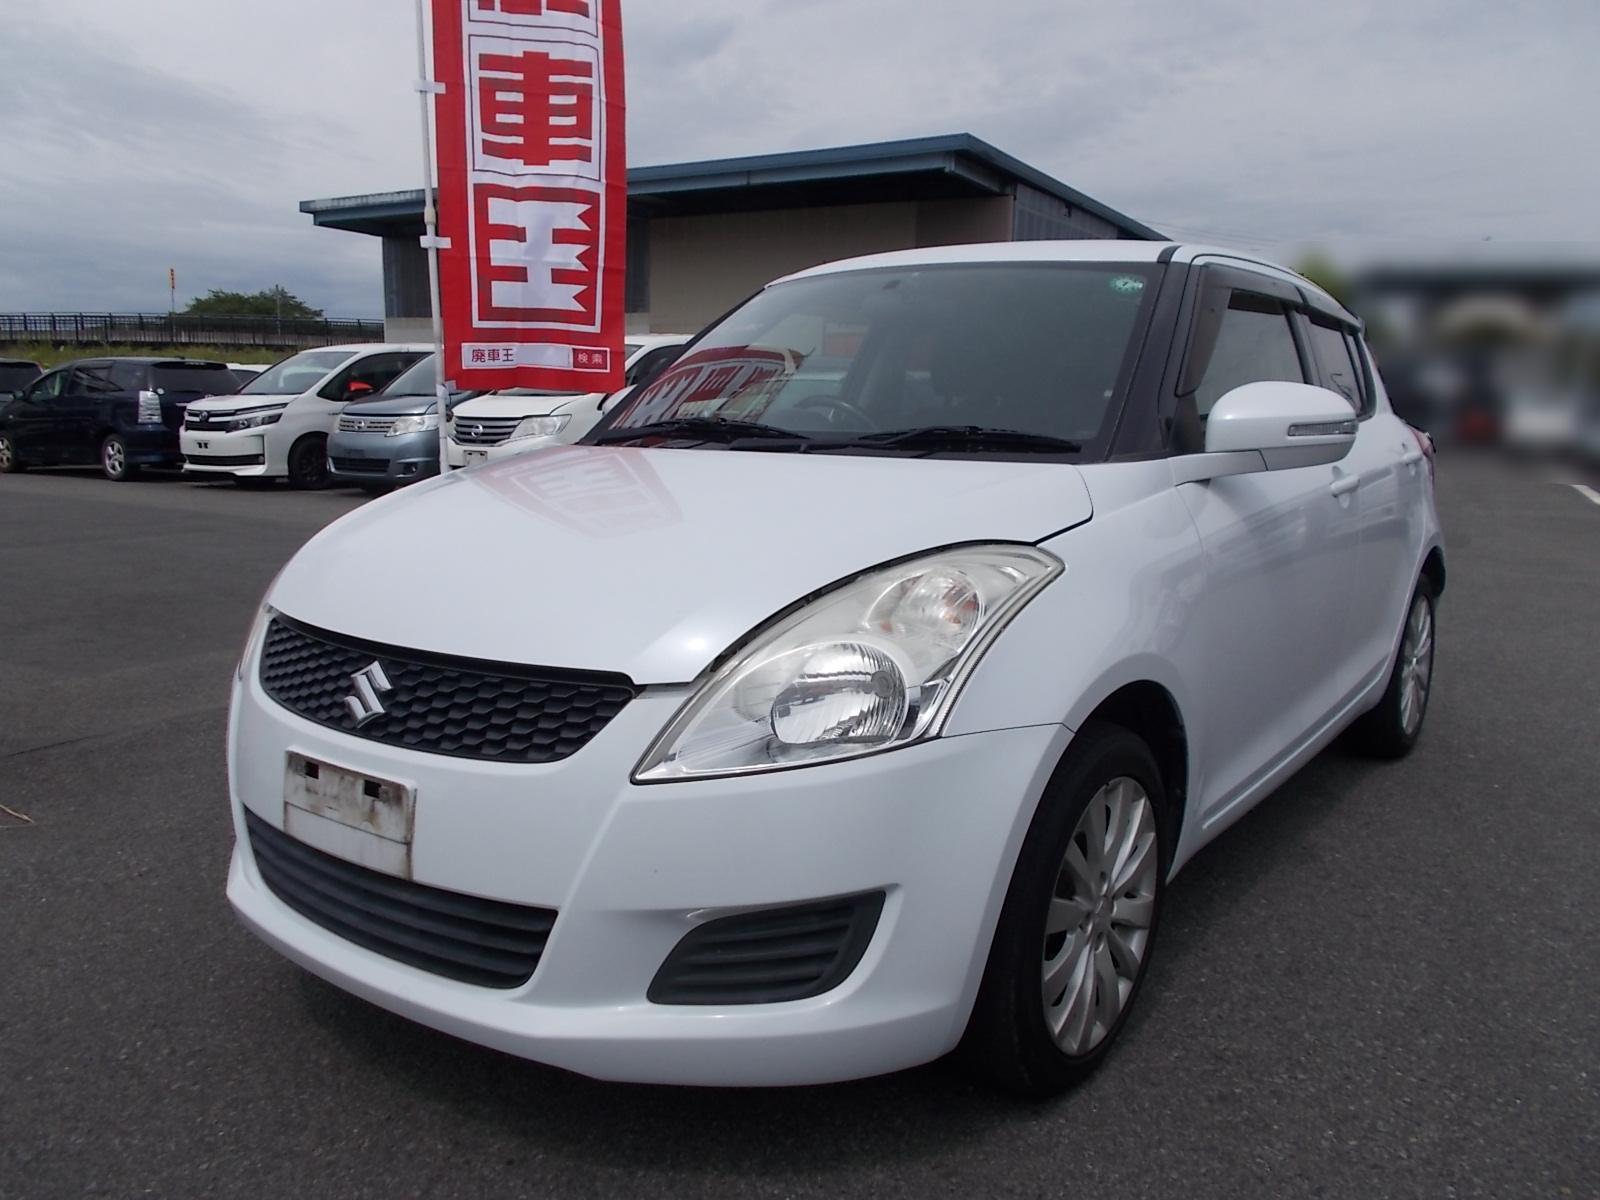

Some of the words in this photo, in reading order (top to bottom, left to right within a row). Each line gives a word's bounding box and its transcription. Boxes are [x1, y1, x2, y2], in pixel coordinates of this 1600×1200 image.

[478, 0, 592, 312] 車王
[473, 348, 514, 362] 廃車王
